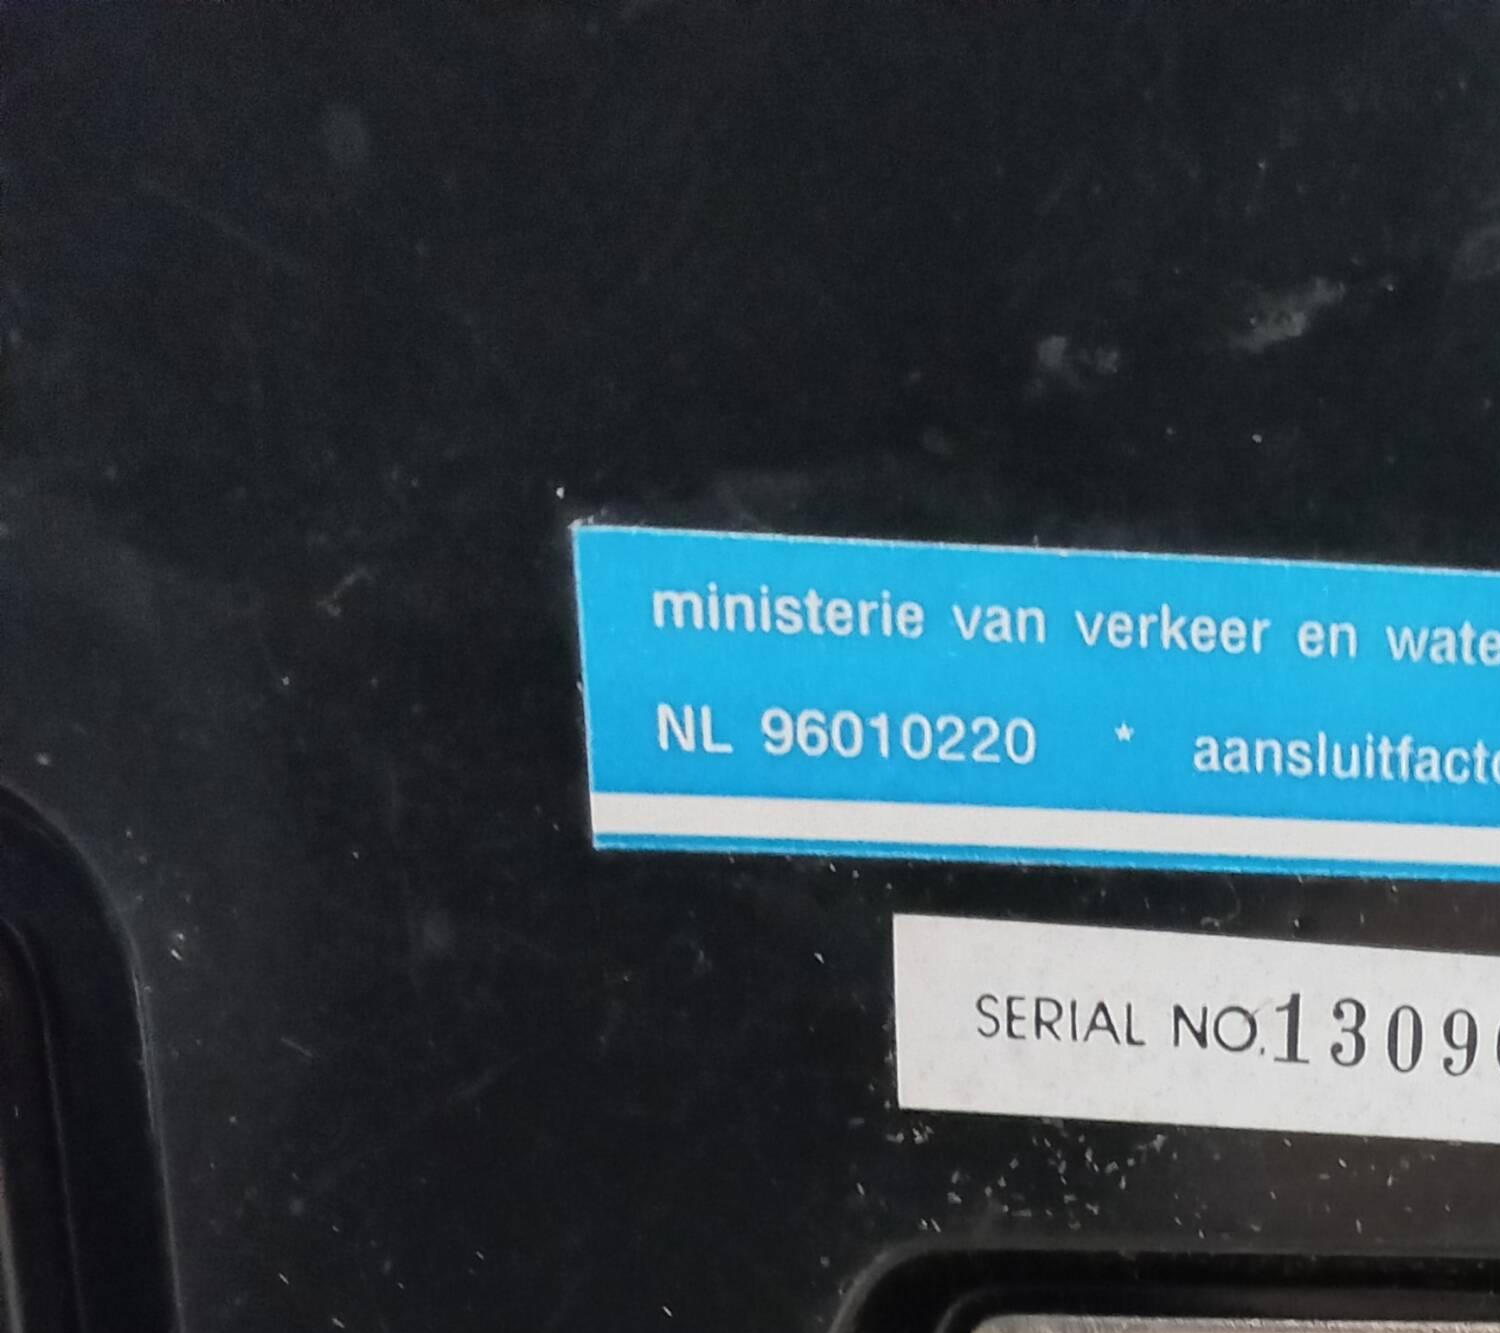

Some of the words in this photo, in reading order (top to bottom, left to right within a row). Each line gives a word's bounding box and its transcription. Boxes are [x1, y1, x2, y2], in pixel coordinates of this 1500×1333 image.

[652, 582, 925, 639] ministerie
[952, 605, 1046, 646] van
[1075, 603, 1271, 654] verkeer
[1297, 620, 1358, 659] en
[656, 703, 733, 754] NL
[760, 707, 1037, 765] 96010220
[975, 993, 1146, 1047] SERIAL
